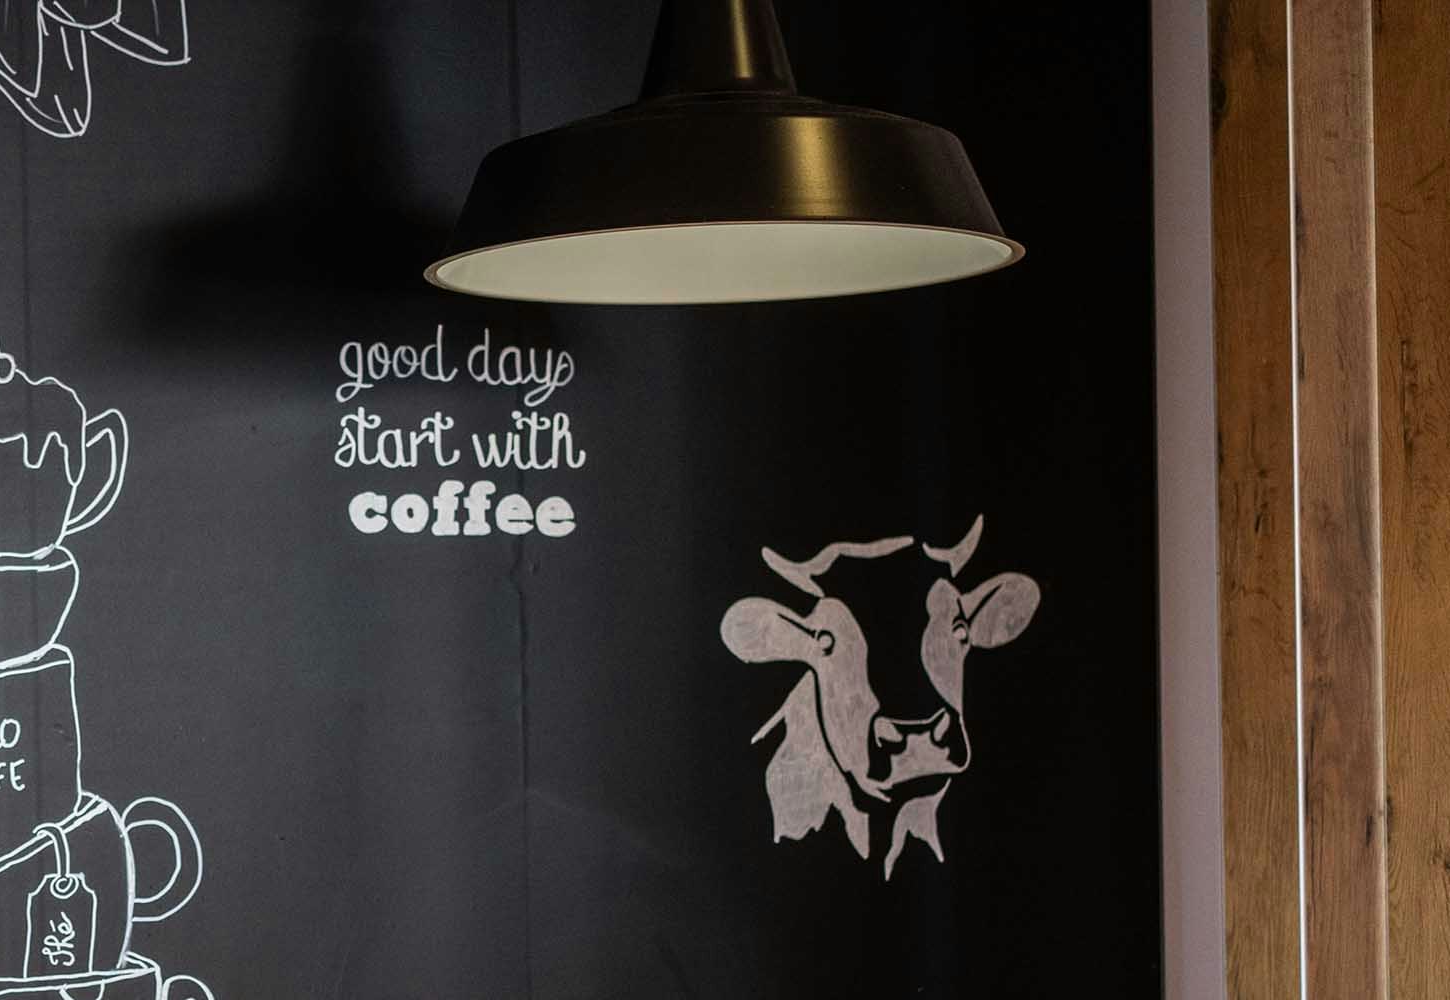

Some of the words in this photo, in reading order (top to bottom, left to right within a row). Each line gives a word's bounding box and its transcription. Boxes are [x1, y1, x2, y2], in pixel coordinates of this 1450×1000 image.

[335, 324, 458, 403] good
[467, 327, 575, 407] days
[334, 406, 461, 469] start
[471, 410, 587, 470] with
[348, 479, 577, 538] coffee
